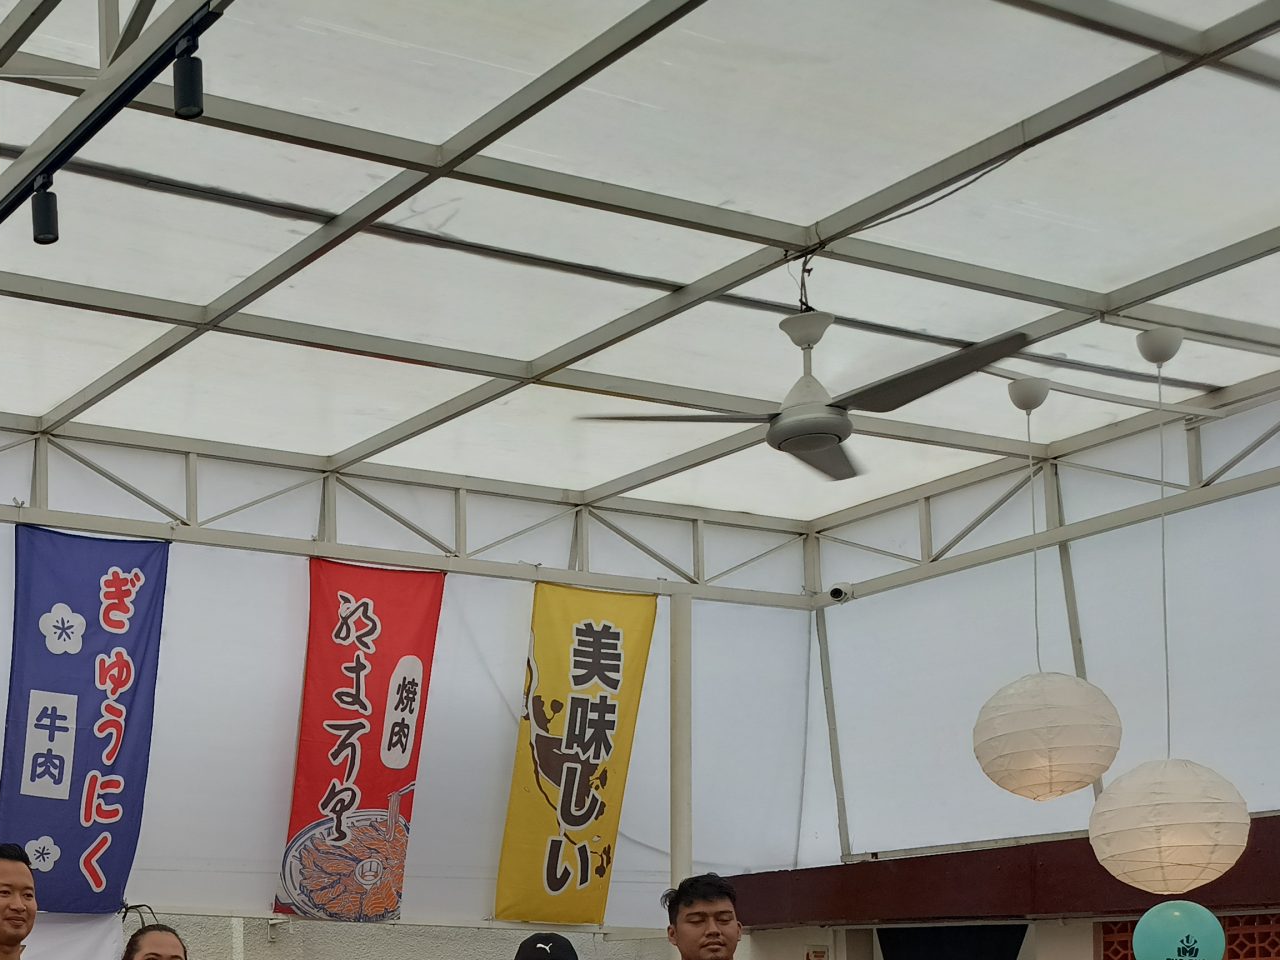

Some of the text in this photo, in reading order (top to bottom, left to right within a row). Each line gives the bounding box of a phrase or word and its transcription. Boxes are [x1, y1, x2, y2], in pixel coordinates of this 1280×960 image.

[29, 705, 70, 786] 牛肉
[387, 676, 419, 753] 焼肉
[546, 622, 622, 892] 美味しい
